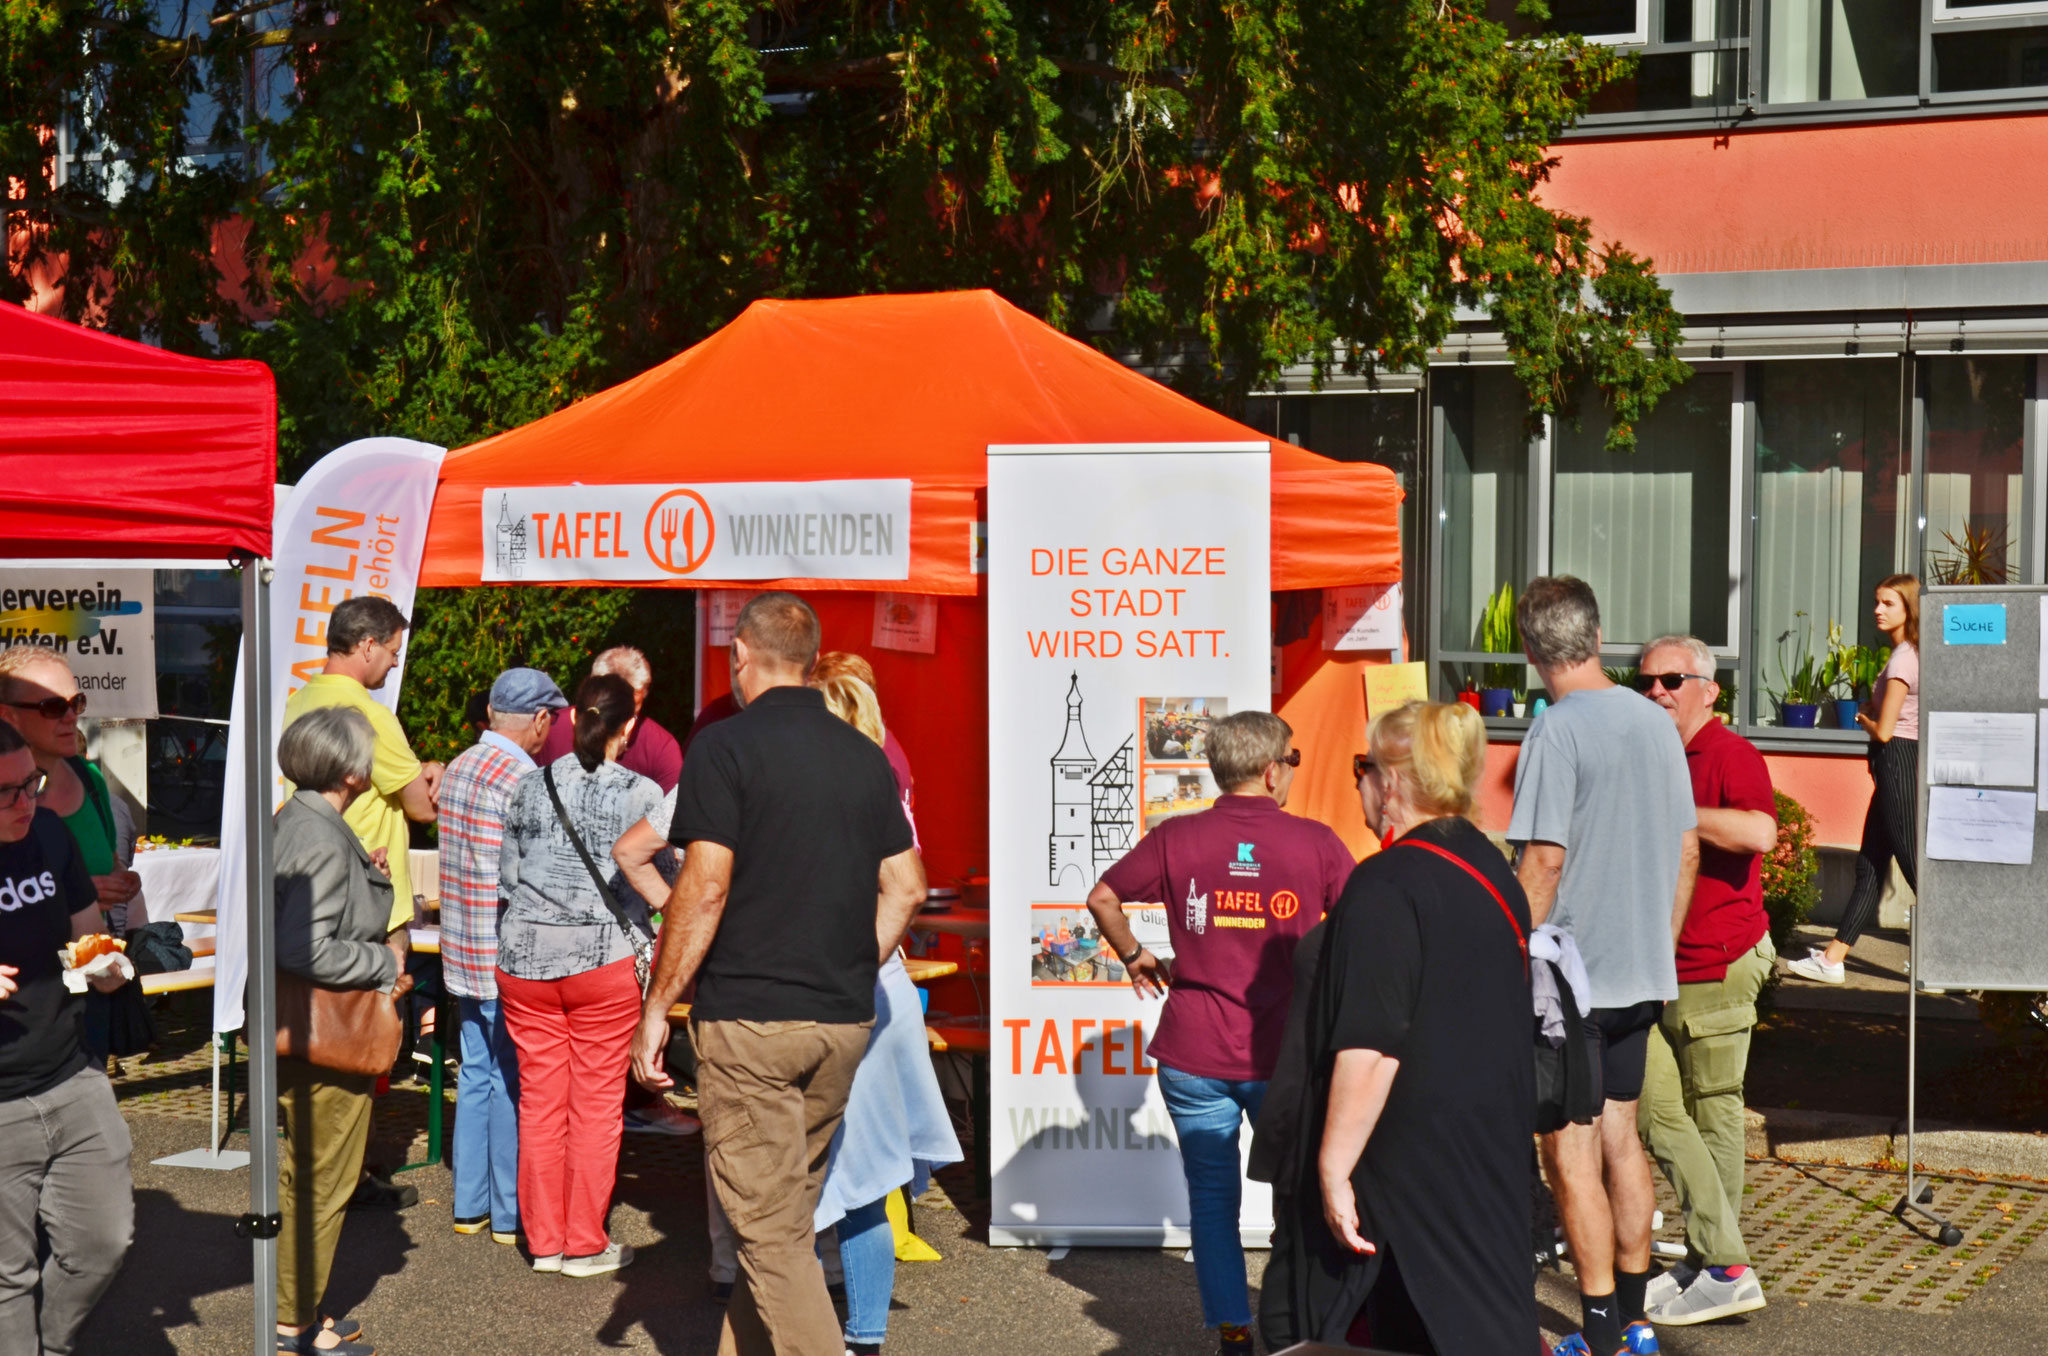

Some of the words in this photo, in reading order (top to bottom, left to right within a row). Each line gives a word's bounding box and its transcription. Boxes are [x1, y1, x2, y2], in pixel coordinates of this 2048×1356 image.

[531, 511, 629, 559] TAFEL
[728, 513, 893, 557] WINNENDEN
[1031, 548, 1089, 576] DIE
[1101, 547, 1227, 576] GANZE
[0, 581, 122, 613] erverein
[287, 506, 367, 696] AFELN
[1070, 589, 1187, 617] STADT
[1949, 616, 1994, 632] SUCHE
[77, 629, 123, 655] e.V.
[1027, 630, 1123, 658] WIRD
[1136, 630, 1230, 658] SATT.
[1237, 842, 1255, 862] K
[1214, 890, 1264, 912] TAFEL
[1213, 916, 1266, 929] WINNENDEN
[1003, 1019, 1158, 1075] TAFEL
